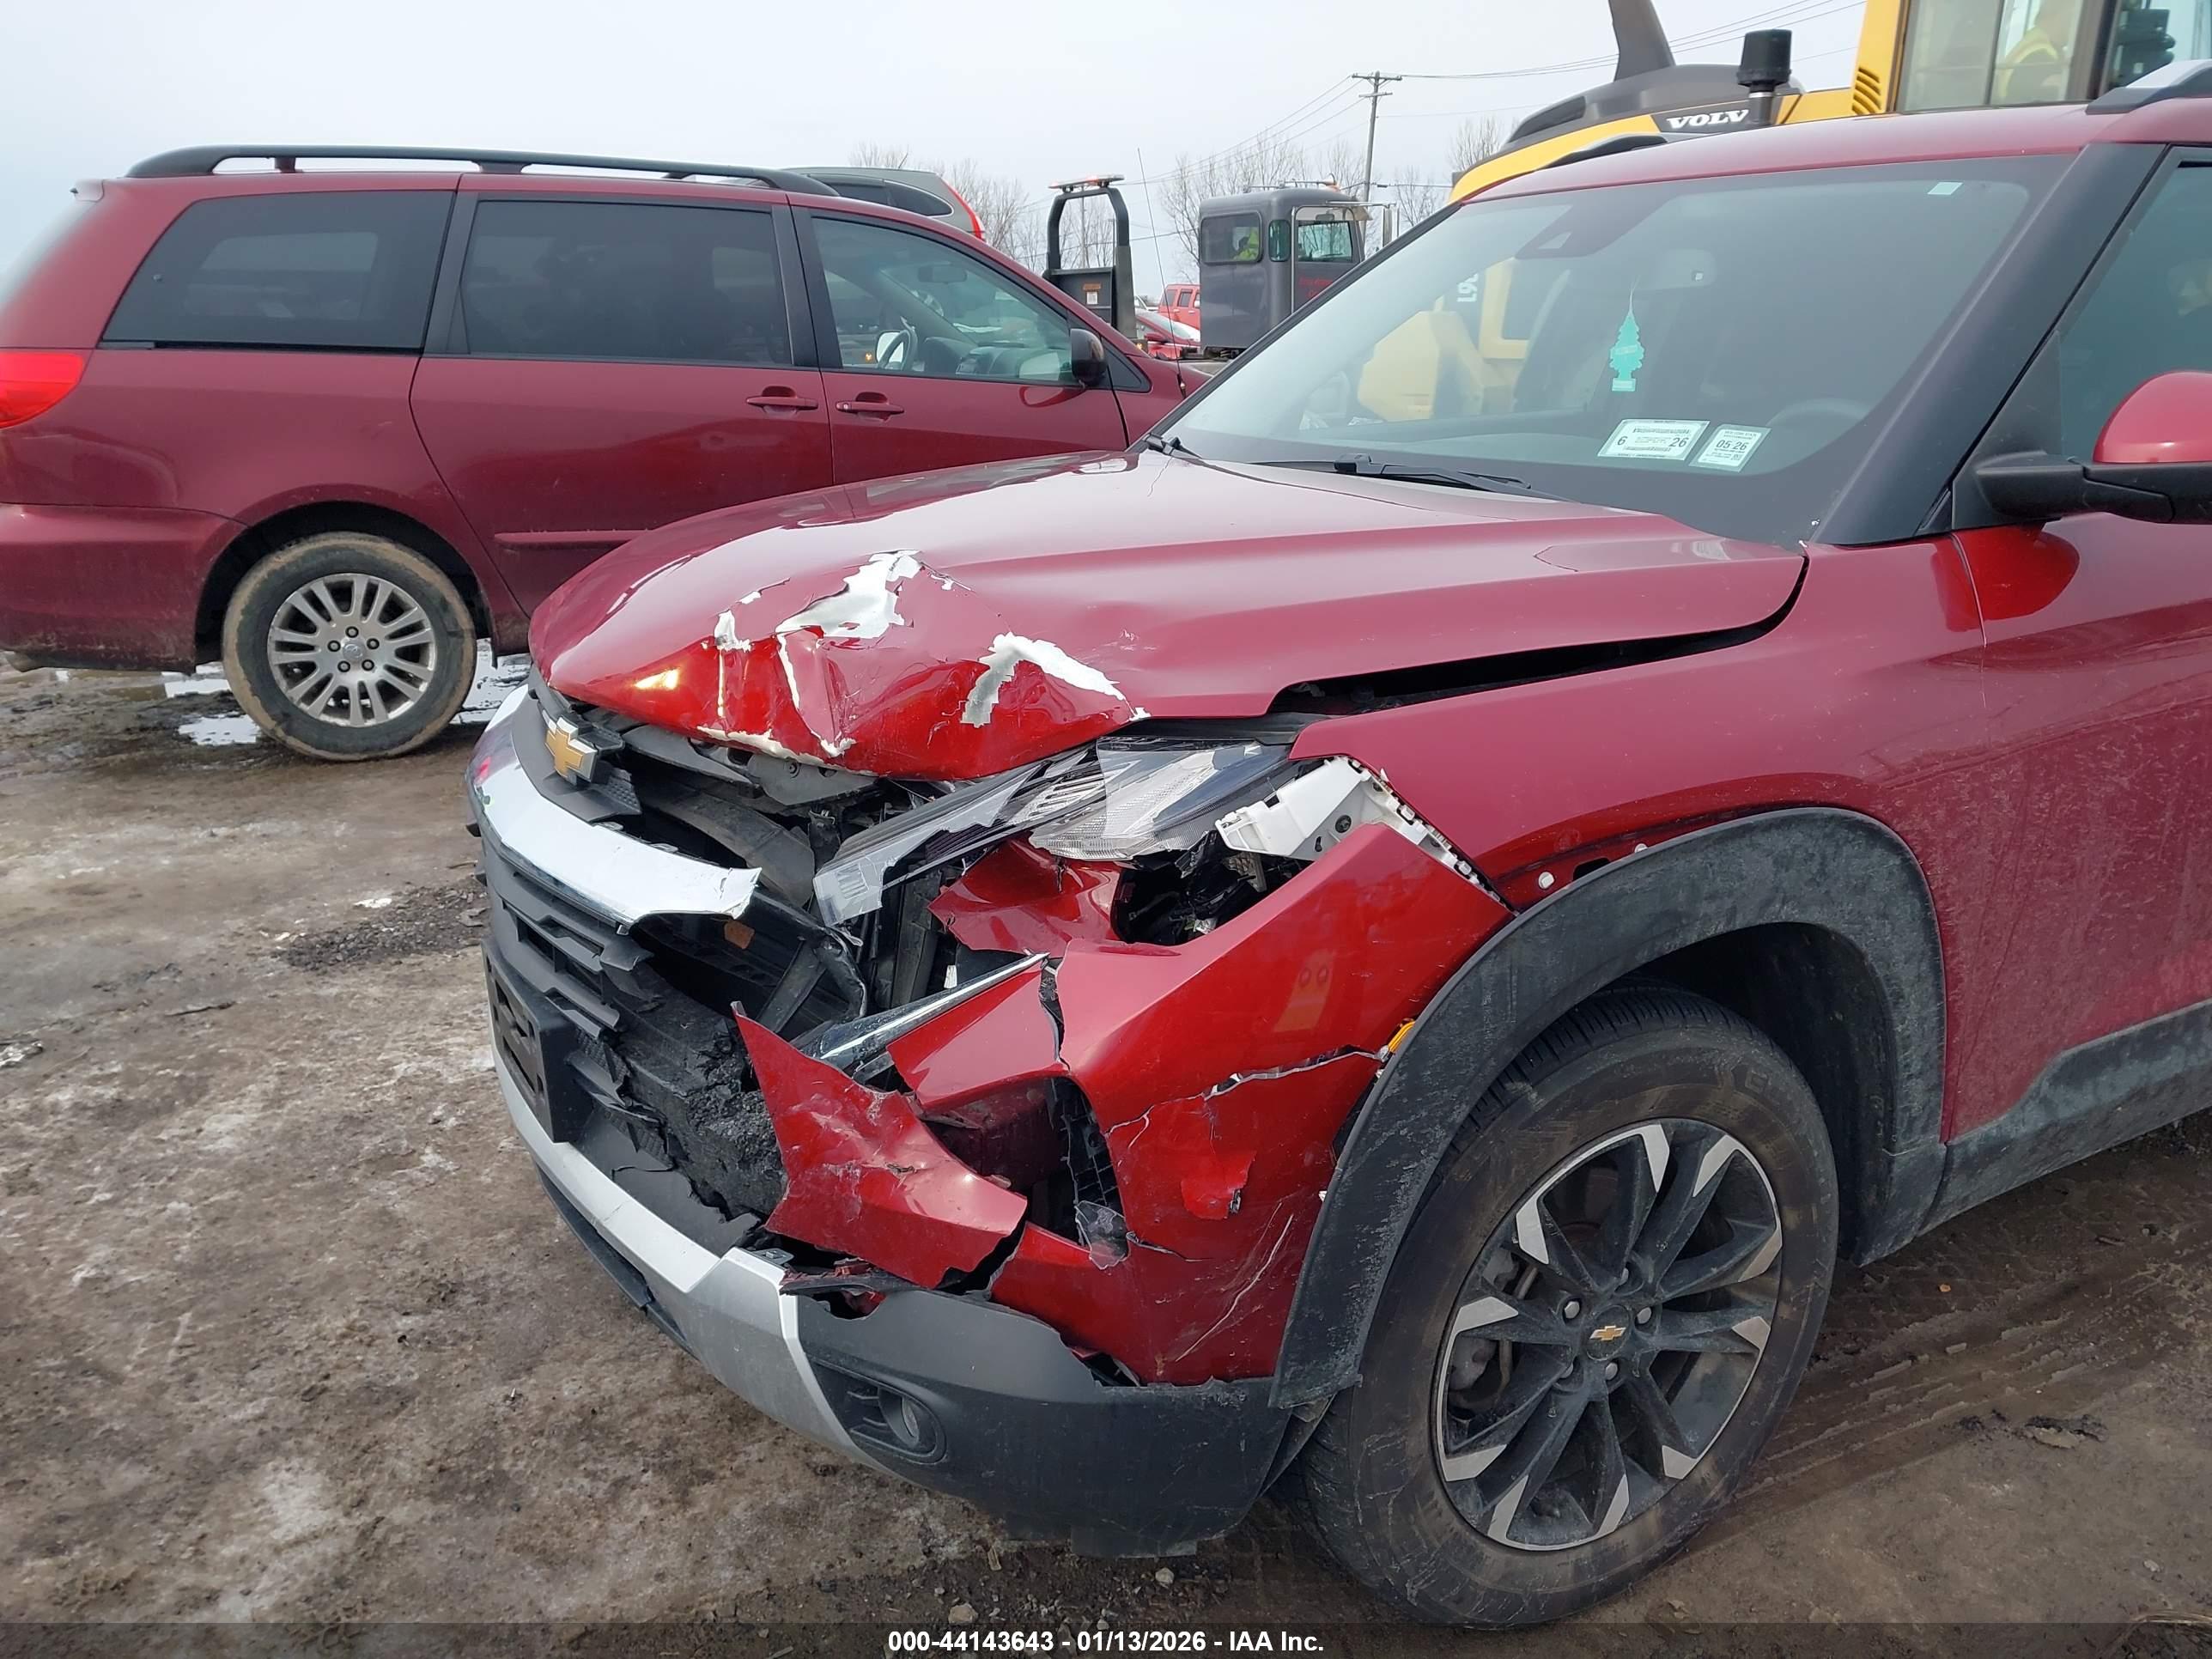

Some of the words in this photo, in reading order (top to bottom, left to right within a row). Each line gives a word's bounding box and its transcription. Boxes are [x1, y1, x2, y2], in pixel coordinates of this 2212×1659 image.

[1667, 109, 1749, 130] VOLV
[1617, 435, 1628, 446] 6
[1668, 437, 1690, 447] 26
[1716, 440, 1732, 449] 05
[1732, 441, 1749, 451] 26
